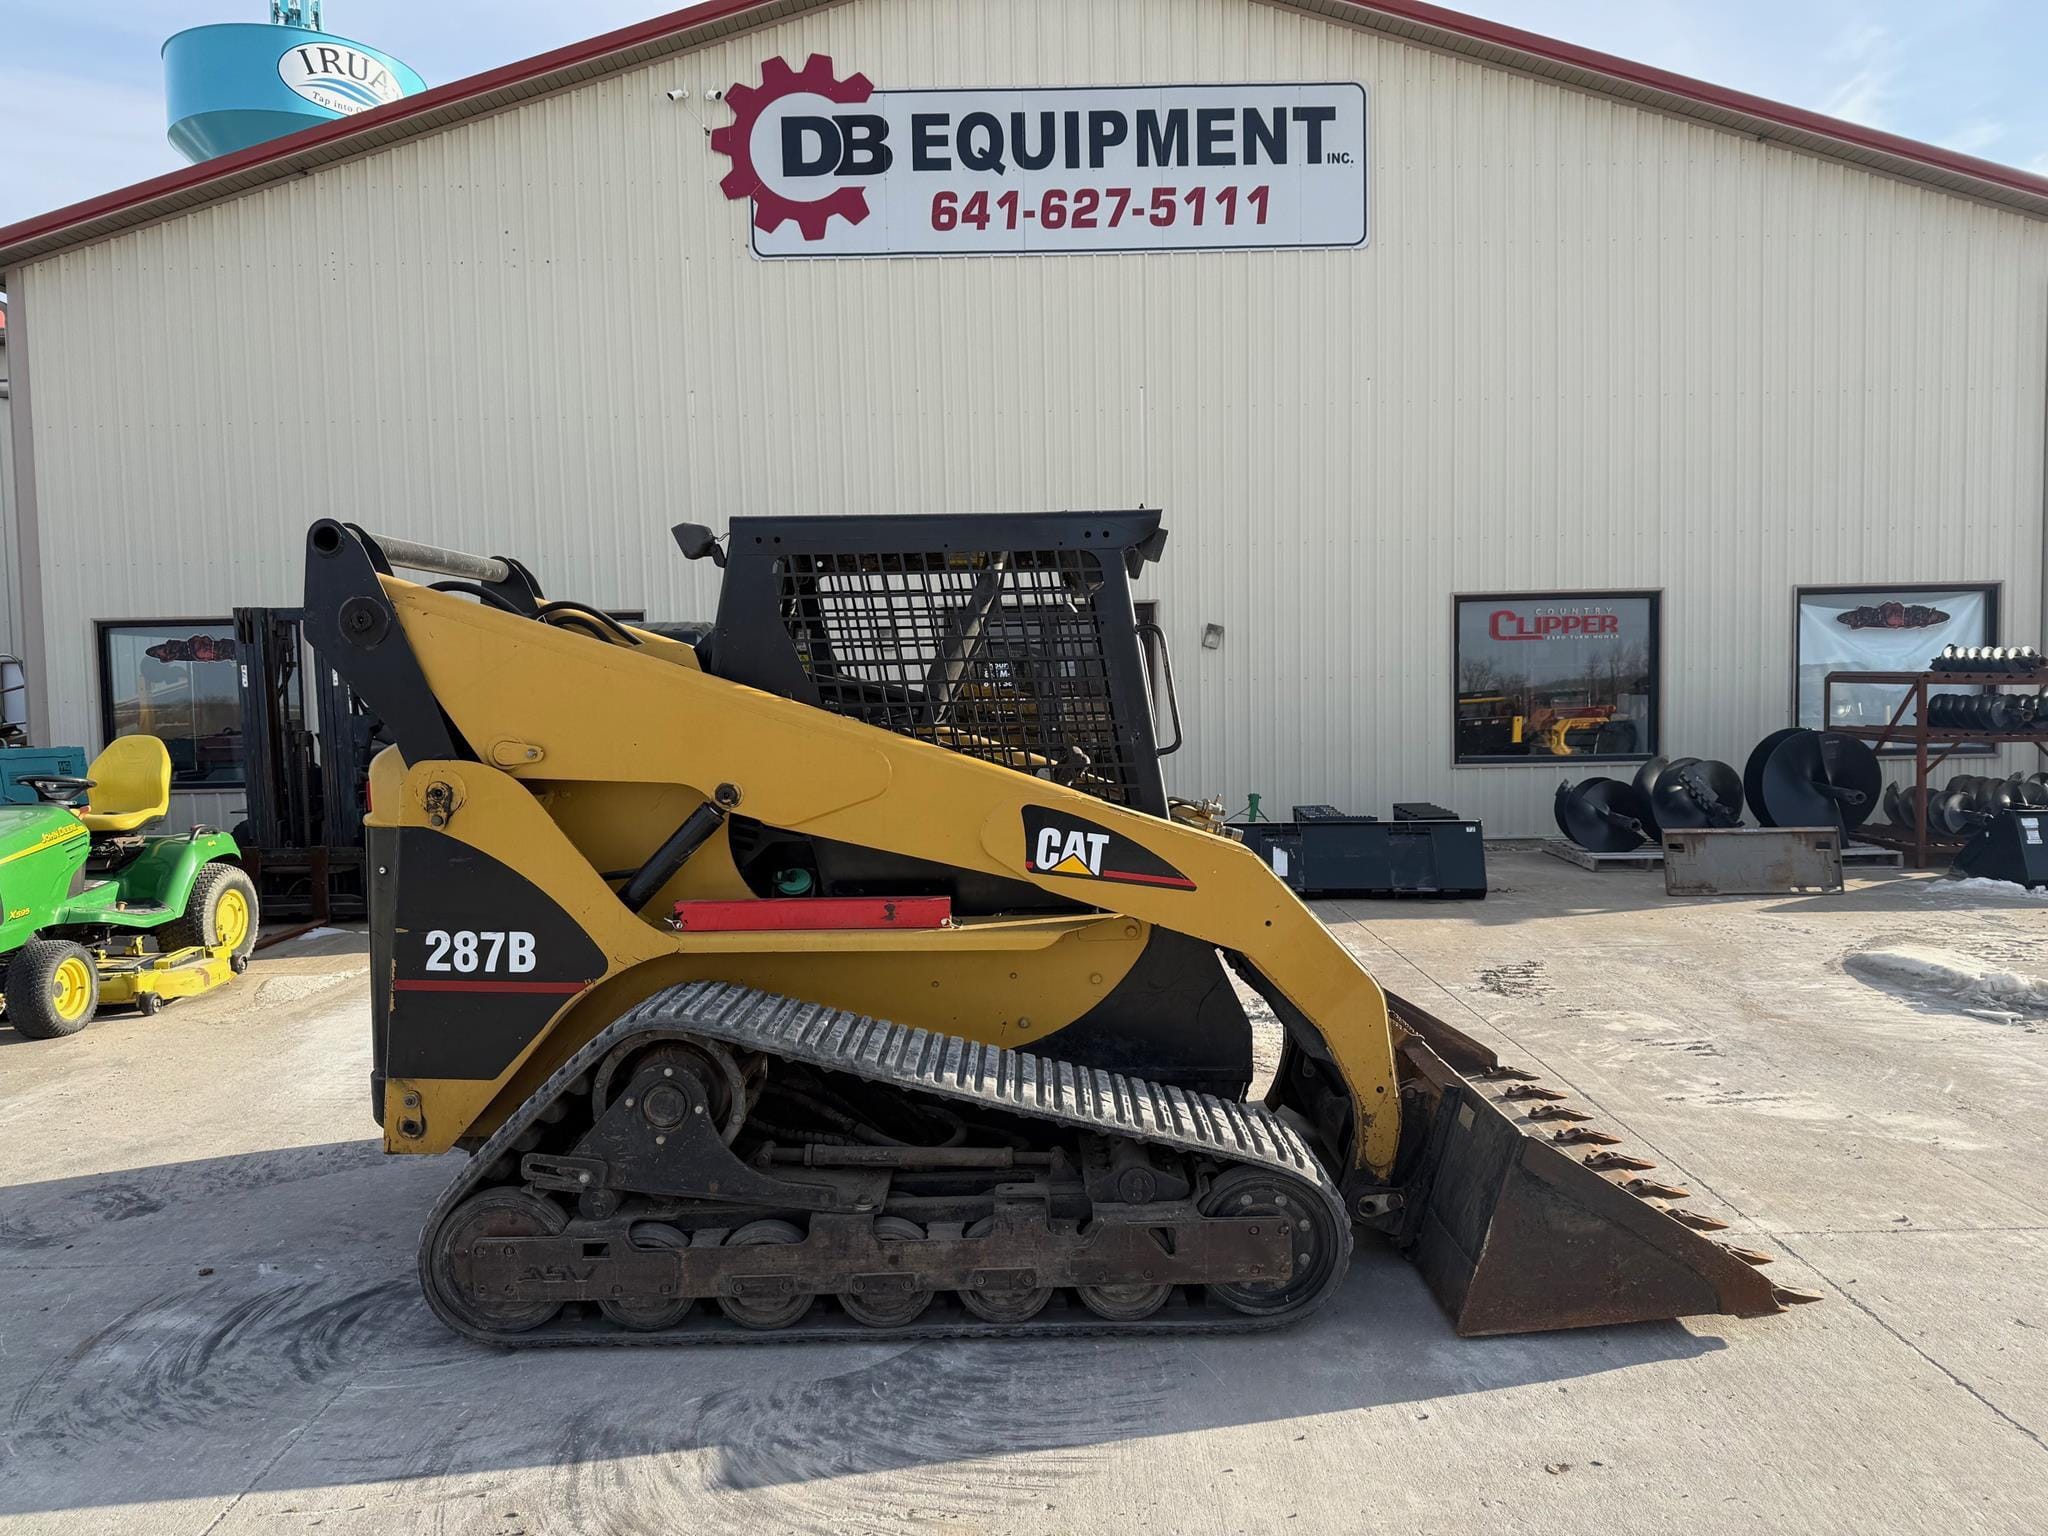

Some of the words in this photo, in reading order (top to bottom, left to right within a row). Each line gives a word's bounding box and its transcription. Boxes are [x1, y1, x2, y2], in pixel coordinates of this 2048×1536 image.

[313, 91, 331, 106] Tap
[334, 99, 353, 113] into
[781, 114, 893, 177] DB
[911, 106, 1337, 176] EQUIPMENT
[1326, 152, 1355, 165] INC.
[931, 185, 1270, 232] 641-627-5111
[1488, 610, 1619, 641] CLIPPER
[1535, 607, 1613, 616] COUNTRY
[1036, 827, 1110, 877] CAT
[425, 929, 537, 973] 287B
